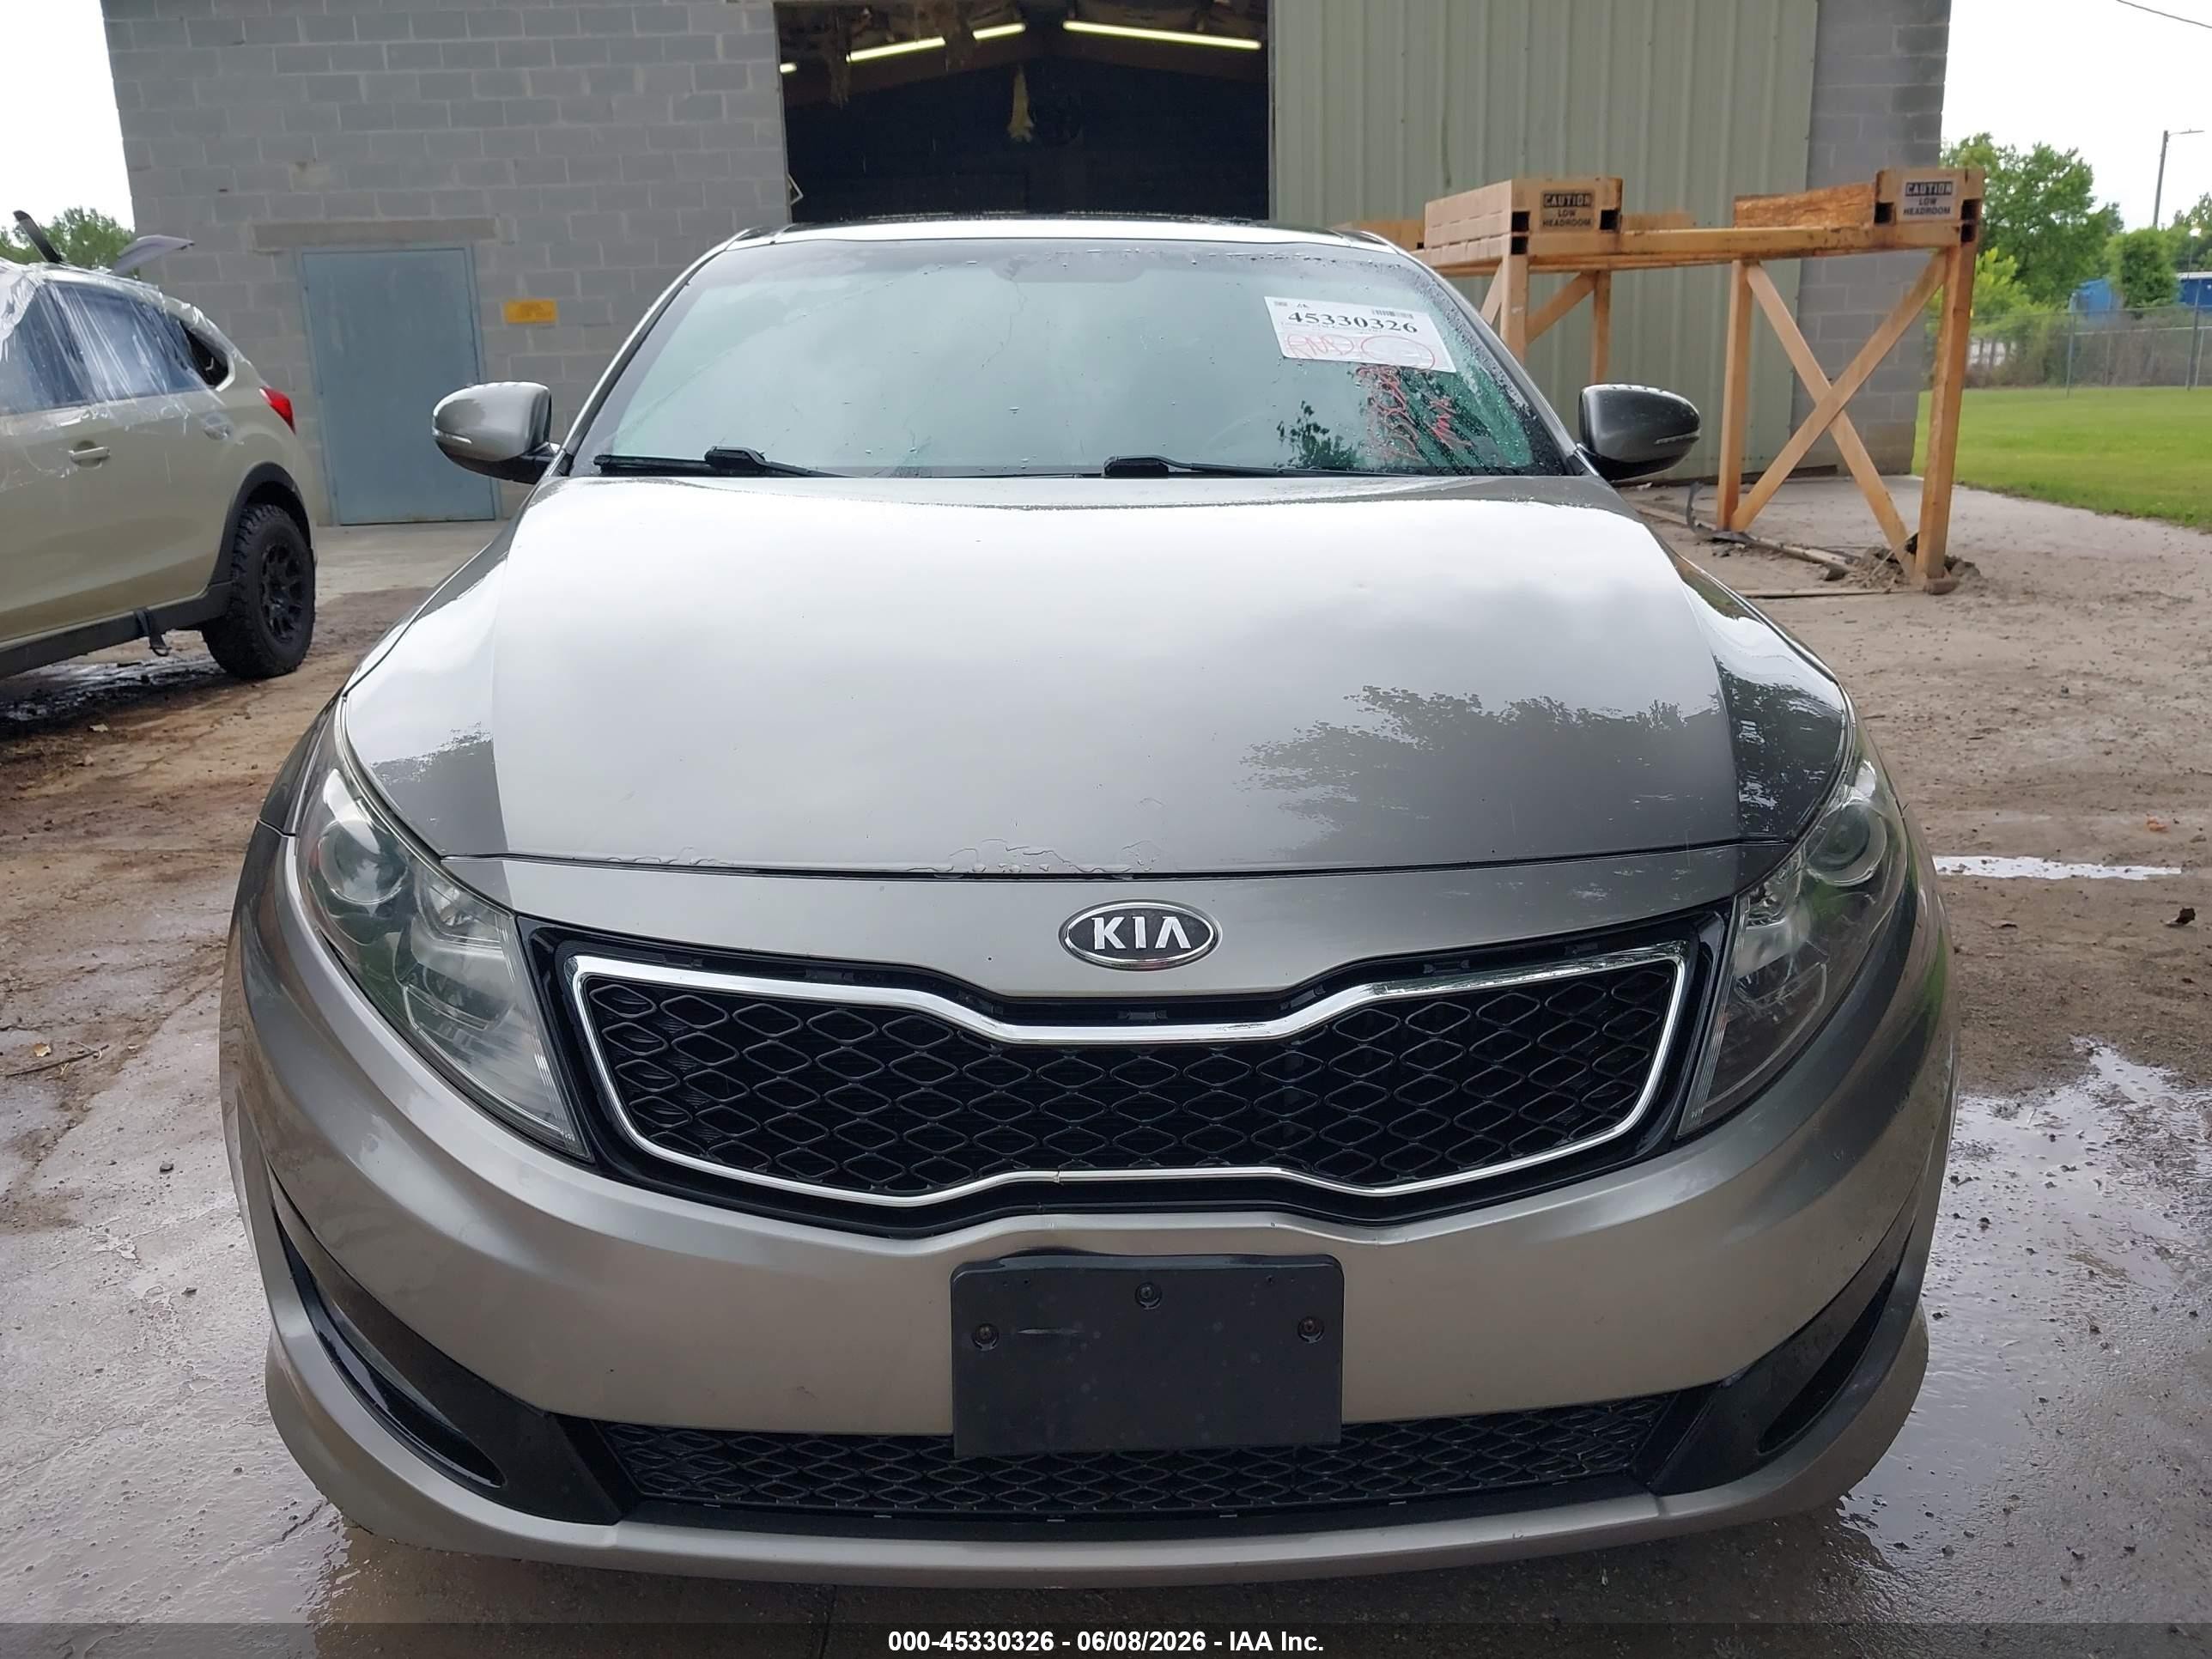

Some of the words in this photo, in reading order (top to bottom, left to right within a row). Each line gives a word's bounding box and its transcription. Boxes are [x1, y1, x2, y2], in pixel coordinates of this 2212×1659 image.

[1906, 182, 1952, 195] CAUTION
[1544, 193, 1592, 206] CAUTION
[1918, 198, 1937, 206] LOW
[1558, 209, 1577, 217] LOW
[1903, 207, 1951, 216] HEADROOM
[1288, 312, 1419, 333] 45330326
[1091, 916, 1192, 950] KIA
